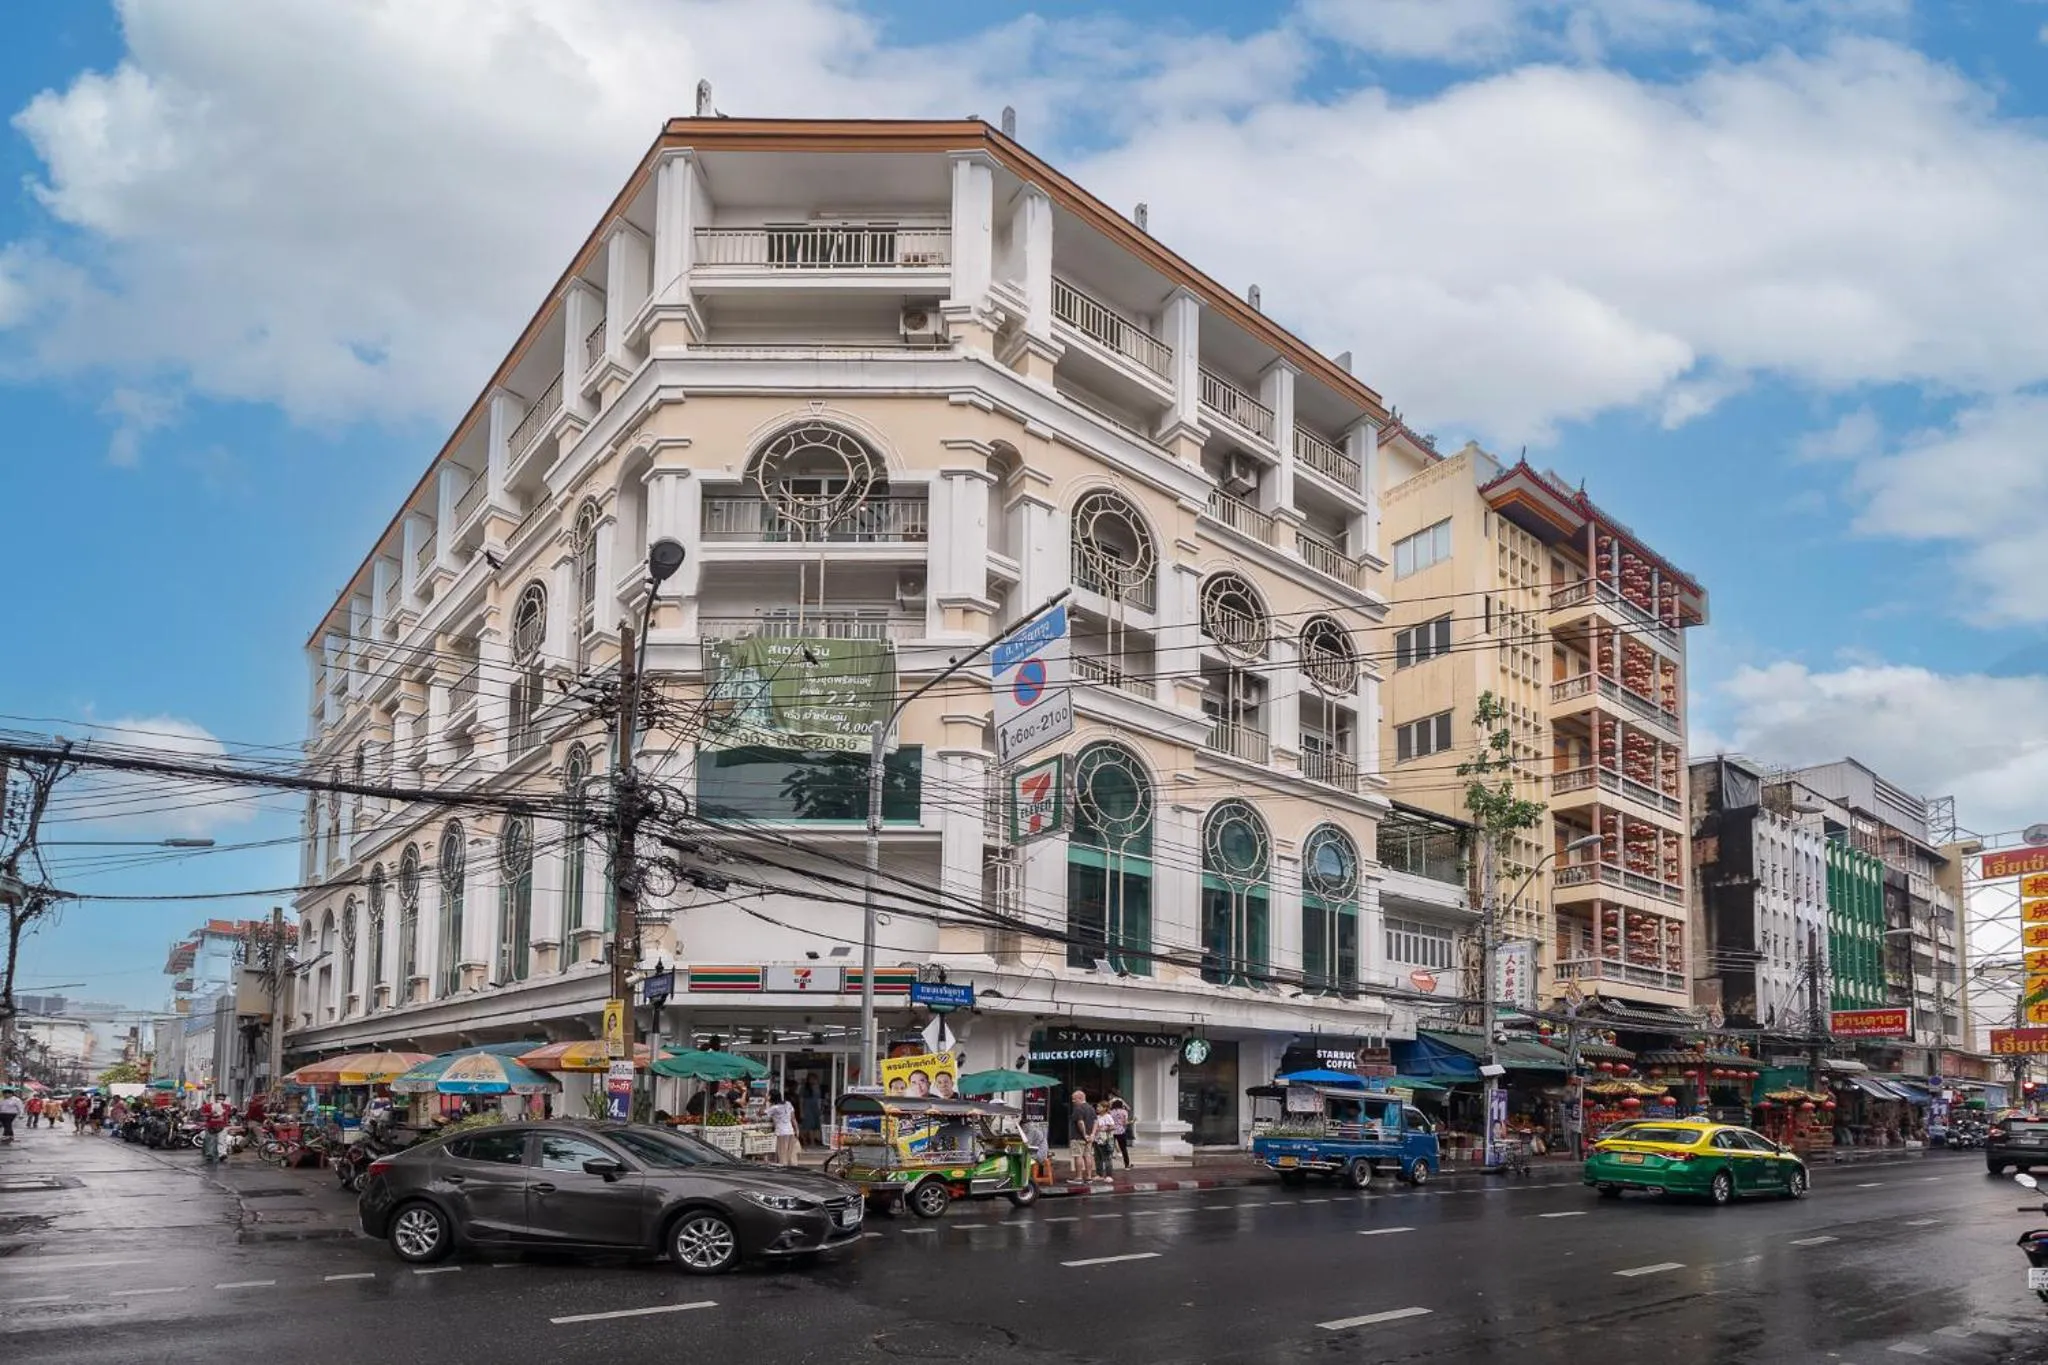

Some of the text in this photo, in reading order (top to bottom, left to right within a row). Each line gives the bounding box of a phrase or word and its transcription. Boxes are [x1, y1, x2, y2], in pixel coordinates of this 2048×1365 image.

[1010, 707, 1067, 746] 0600-2100
[1058, 1031, 1179, 1047] STATION ONE
[1028, 1050, 1069, 1060] ARBUCKS
[1316, 1050, 1355, 1060] STARBUC
